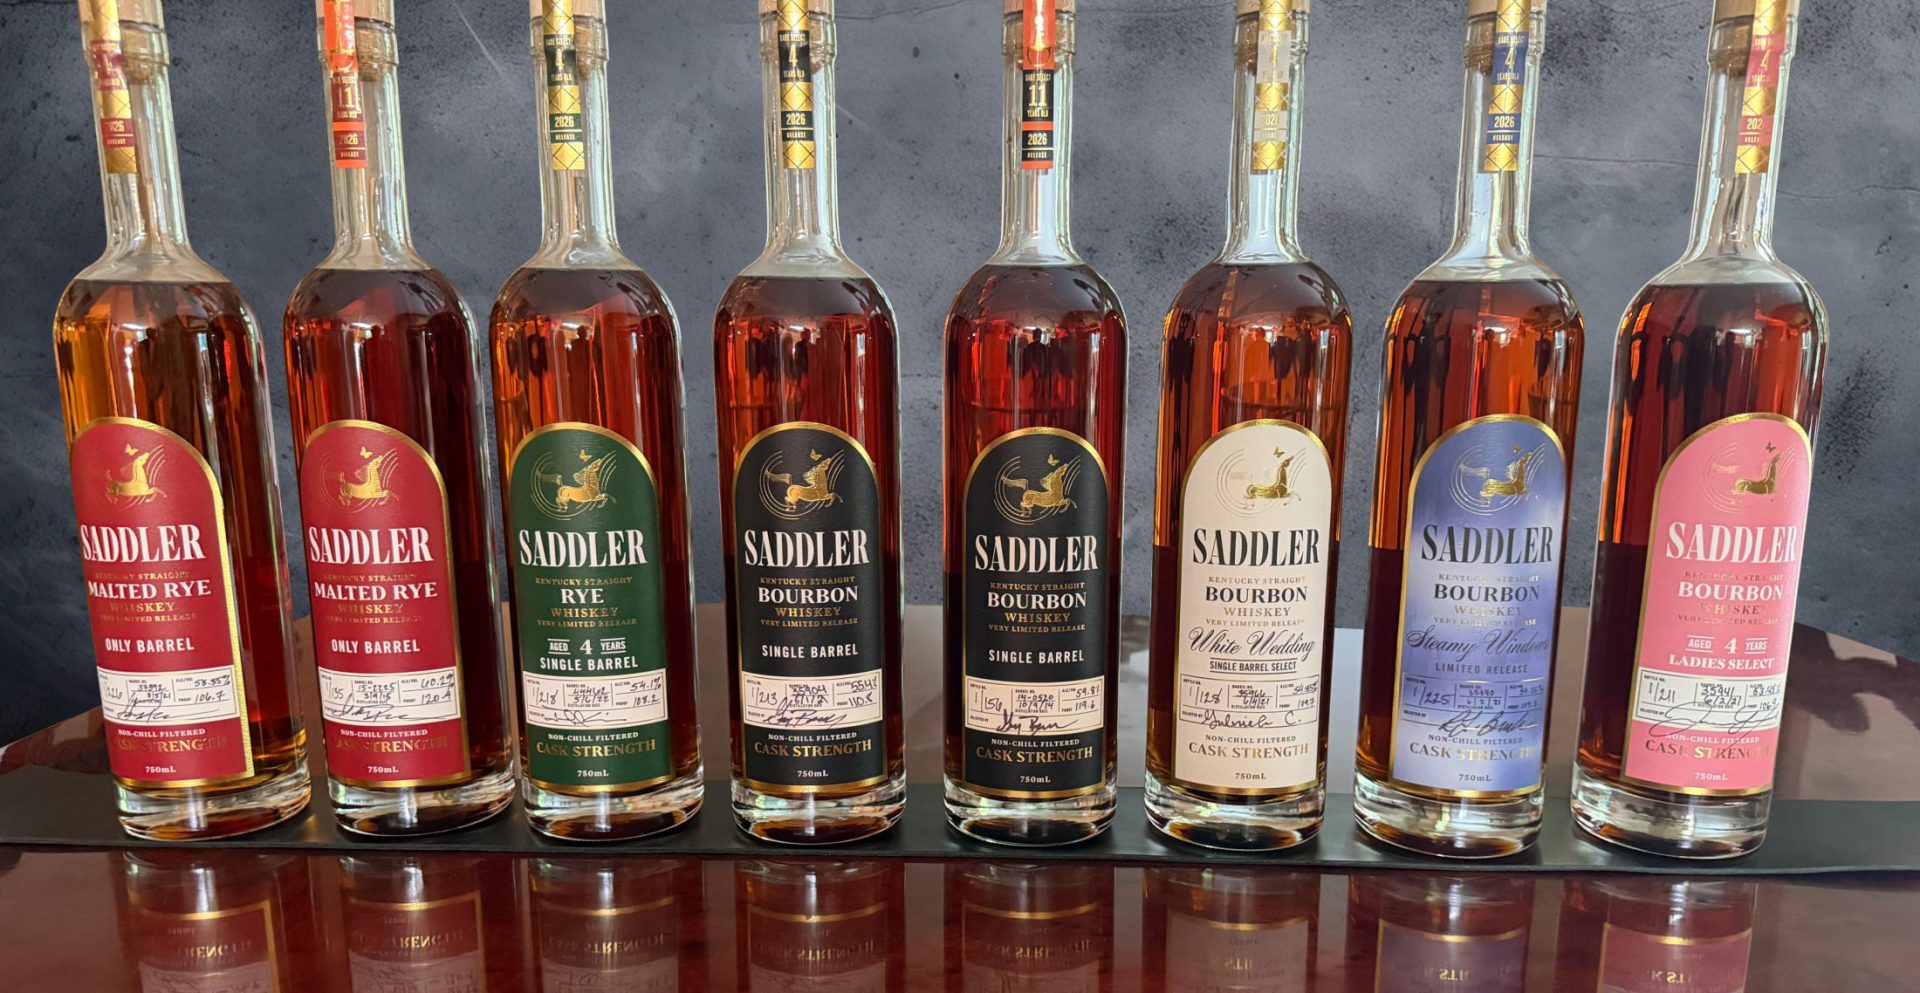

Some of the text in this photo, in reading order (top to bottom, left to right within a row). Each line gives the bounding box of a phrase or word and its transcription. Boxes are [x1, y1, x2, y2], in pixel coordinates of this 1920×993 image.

[789, 44, 798, 67] 4
[1505, 48, 1515, 70] 4
[1760, 50, 1771, 70] 4
[1029, 84, 1047, 107] 11
[786, 114, 806, 125] 2026
[1027, 110, 1040, 118] YEARS
[555, 116, 575, 127] 2026
[1494, 117, 1514, 128] 2026
[339, 134, 358, 145] 2026
[1028, 134, 1047, 145] 2026
[80, 524, 207, 563] SADDLER
[308, 527, 433, 564] SADDLER
[519, 529, 647, 567] SADDLER
[745, 529, 870, 567] SADDLER
[1193, 528, 1320, 566] SADDLER
[1421, 524, 1553, 564] SADDLER
[1666, 522, 1797, 563] SADDLER
[975, 535, 1098, 573] SADDLER
[584, 577, 632, 585] STRAIGHT
[761, 576, 855, 585] KENTUCKY STRAIGHT
[991, 582, 1085, 590] KENTUCKY STRAIGHT
[1209, 576, 1306, 584] KENTUCKY STRAIGHT
[88, 579, 211, 600] MALTED RYE
[314, 582, 437, 601] MALTED RYE
[560, 588, 604, 604] RYE
[758, 586, 858, 604] BOURBON
[1206, 586, 1307, 603] BOURBON
[1434, 584, 1539, 602] BOURBON
[1678, 582, 1783, 601] BOURBON
[988, 592, 1087, 609] BOURBON
[551, 608, 618, 618] WHISKEY
[775, 607, 842, 617] WHISKEY
[1004, 613, 1071, 622] WHISKEY
[1224, 607, 1291, 617] WHISKEY
[599, 619, 637, 627] RELEASE
[823, 618, 858, 626] RELEASE
[989, 624, 1008, 632] VERY
[1052, 624, 1085, 632] RELEASE
[1230, 619, 1268, 627] LIMITED
[105, 638, 194, 653] ONLY BARREL
[331, 639, 420, 654] ONLY BARREL
[550, 639, 626, 655] AGED 4 YEARS
[1189, 627, 1316, 662] White Wedding
[1406, 625, 1479, 662] Steamy
[1688, 638, 1767, 654] AGED 4 YEARS
[762, 644, 858, 658] SINGLE BARREL
[989, 650, 1084, 663] SINGLE BARREL
[540, 656, 638, 670] SINGLE BARREL
[1210, 661, 1296, 671] SINGLE BARREL SELECT
[1436, 662, 1528, 674] LIMITED RELEASE
[1669, 654, 1774, 670] LADIES SELECT
[630, 676, 661, 691] 54.1%
[195, 690, 225, 704] 106.7
[752, 686, 777, 705] 1/213
[1076, 685, 1100, 698] 59.8%
[1189, 686, 1222, 705] 1/128
[1649, 682, 1675, 702] 1/211
[634, 694, 659, 707] 108.2
[1019, 701, 1054, 710] 10/9/14
[1075, 700, 1095, 711] 119.6
[1285, 710, 1301, 726] C.
[118, 728, 205, 738] NON-CHILL FILTERED
[340, 729, 428, 737] NON-CHILL FILTERED
[596, 732, 638, 741] FILTERED
[817, 732, 857, 741] FILTERED
[1206, 735, 1296, 743] NON-CHILL FILTERED
[1428, 735, 1522, 745] NON-CHILL FILTERED
[1666, 734, 1718, 743] NON-CHILL
[537, 739, 656, 758] CASK STRENGTH
[755, 739, 872, 757] CASK STRENGTH
[991, 739, 1079, 747] NON-CHILL FILTERED
[1189, 742, 1308, 758] CASK STRENGTH
[976, 746, 1092, 763] CASK STRENGTH
[1410, 743, 1534, 761] CASK STRENGTH
[145, 765, 176, 773] 750mL
[1695, 772, 1728, 780] 750mL
[1458, 774, 1491, 782] 750mL
